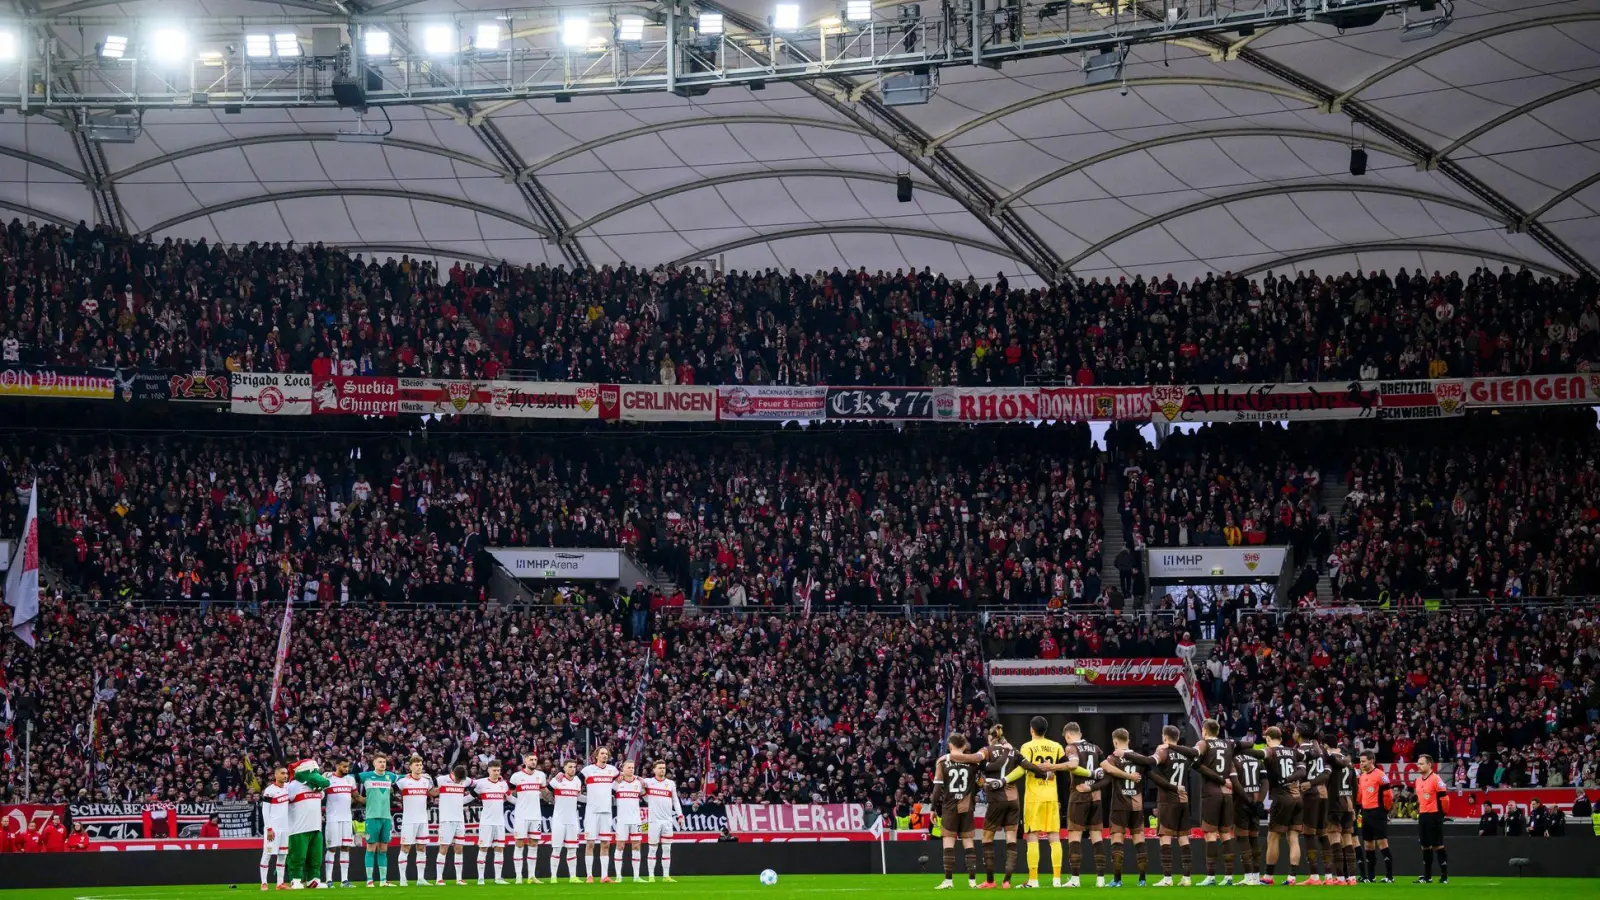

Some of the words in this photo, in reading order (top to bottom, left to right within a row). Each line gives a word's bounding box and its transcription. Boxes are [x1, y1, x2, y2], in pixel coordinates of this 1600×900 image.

[0, 369, 32, 388] Old
[37, 369, 114, 392] Warriors
[232, 374, 279, 388] Brigada
[284, 375, 310, 387] Loca
[343, 380, 395, 395] Suebia
[1381, 382, 1433, 395] BRENZTAL
[1470, 376, 1586, 401] GIENGEN
[508, 388, 576, 412] Hessen
[623, 391, 713, 412] GERLINGEN
[758, 400, 781, 408] Feuer
[783, 400, 790, 408] &
[905, 391, 934, 415] 77
[959, 394, 1040, 420] RHÖN
[1041, 394, 1094, 419] DONAU
[1116, 393, 1152, 419] RIES
[1180, 386, 1245, 421] Alte
[1235, 411, 1289, 420] Stuttgart
[1381, 406, 1441, 419] SCHWABEN
[526, 559, 549, 569] MHP
[550, 559, 578, 570] Arena
[1176, 554, 1203, 566] MHP
[1153, 661, 1178, 681] die
[1086, 754, 1094, 771] 4
[1215, 750, 1225, 773] 5
[1279, 759, 1294, 779] 16
[1306, 757, 1324, 780] 20
[948, 768, 969, 793] 23
[1123, 765, 1137, 789] 11
[1169, 762, 1185, 787] 21
[1242, 762, 1258, 786] 17
[1341, 766, 1350, 789] 2
[69, 803, 142, 816] SCHWABE
[725, 803, 864, 832] WEILERidB
